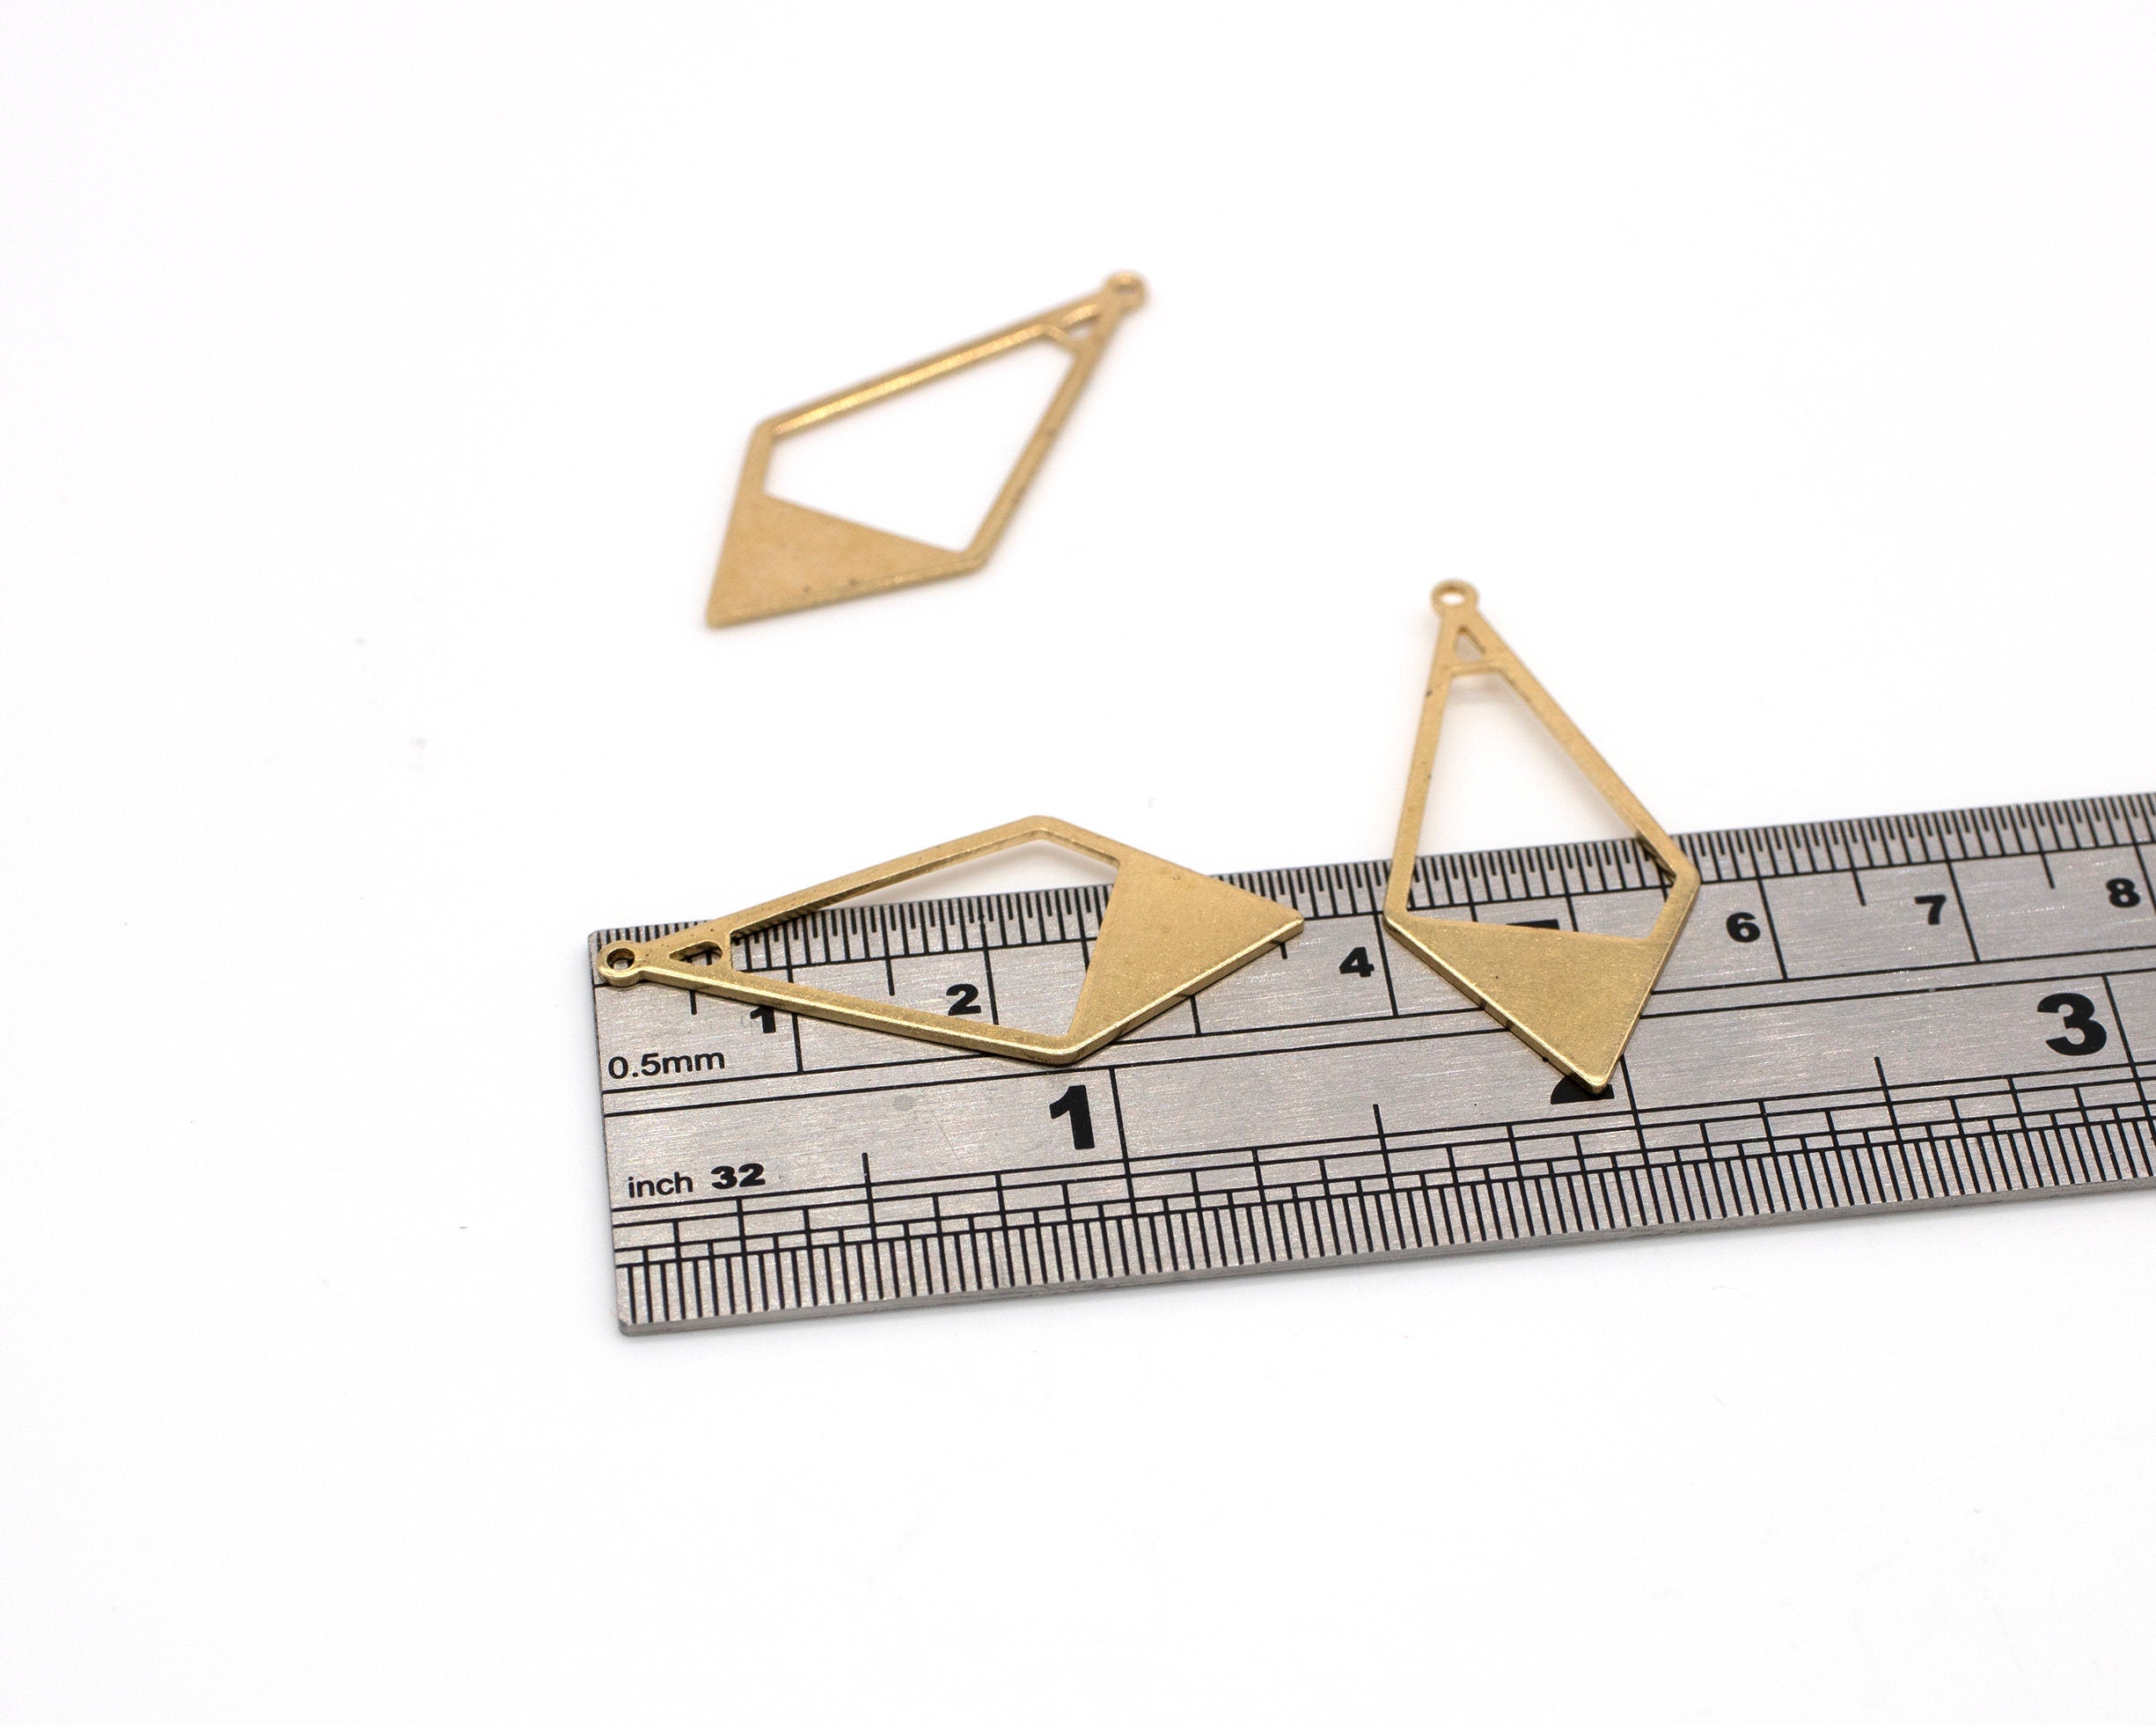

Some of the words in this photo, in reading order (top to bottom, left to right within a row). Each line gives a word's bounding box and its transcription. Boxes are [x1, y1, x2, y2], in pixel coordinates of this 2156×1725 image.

[2106, 877, 2141, 908] 8
[1914, 894, 1947, 926] 7
[1726, 912, 1761, 943] 6
[1339, 946, 1375, 978] 4
[946, 983, 981, 1016] 2
[750, 1005, 776, 1033] 1
[2036, 992, 2108, 1057] 3
[607, 1051, 726, 1079] 0.5mm
[1049, 1084, 1096, 1149] 1
[627, 1171, 693, 1199] inch
[710, 1163, 766, 1189] 32
